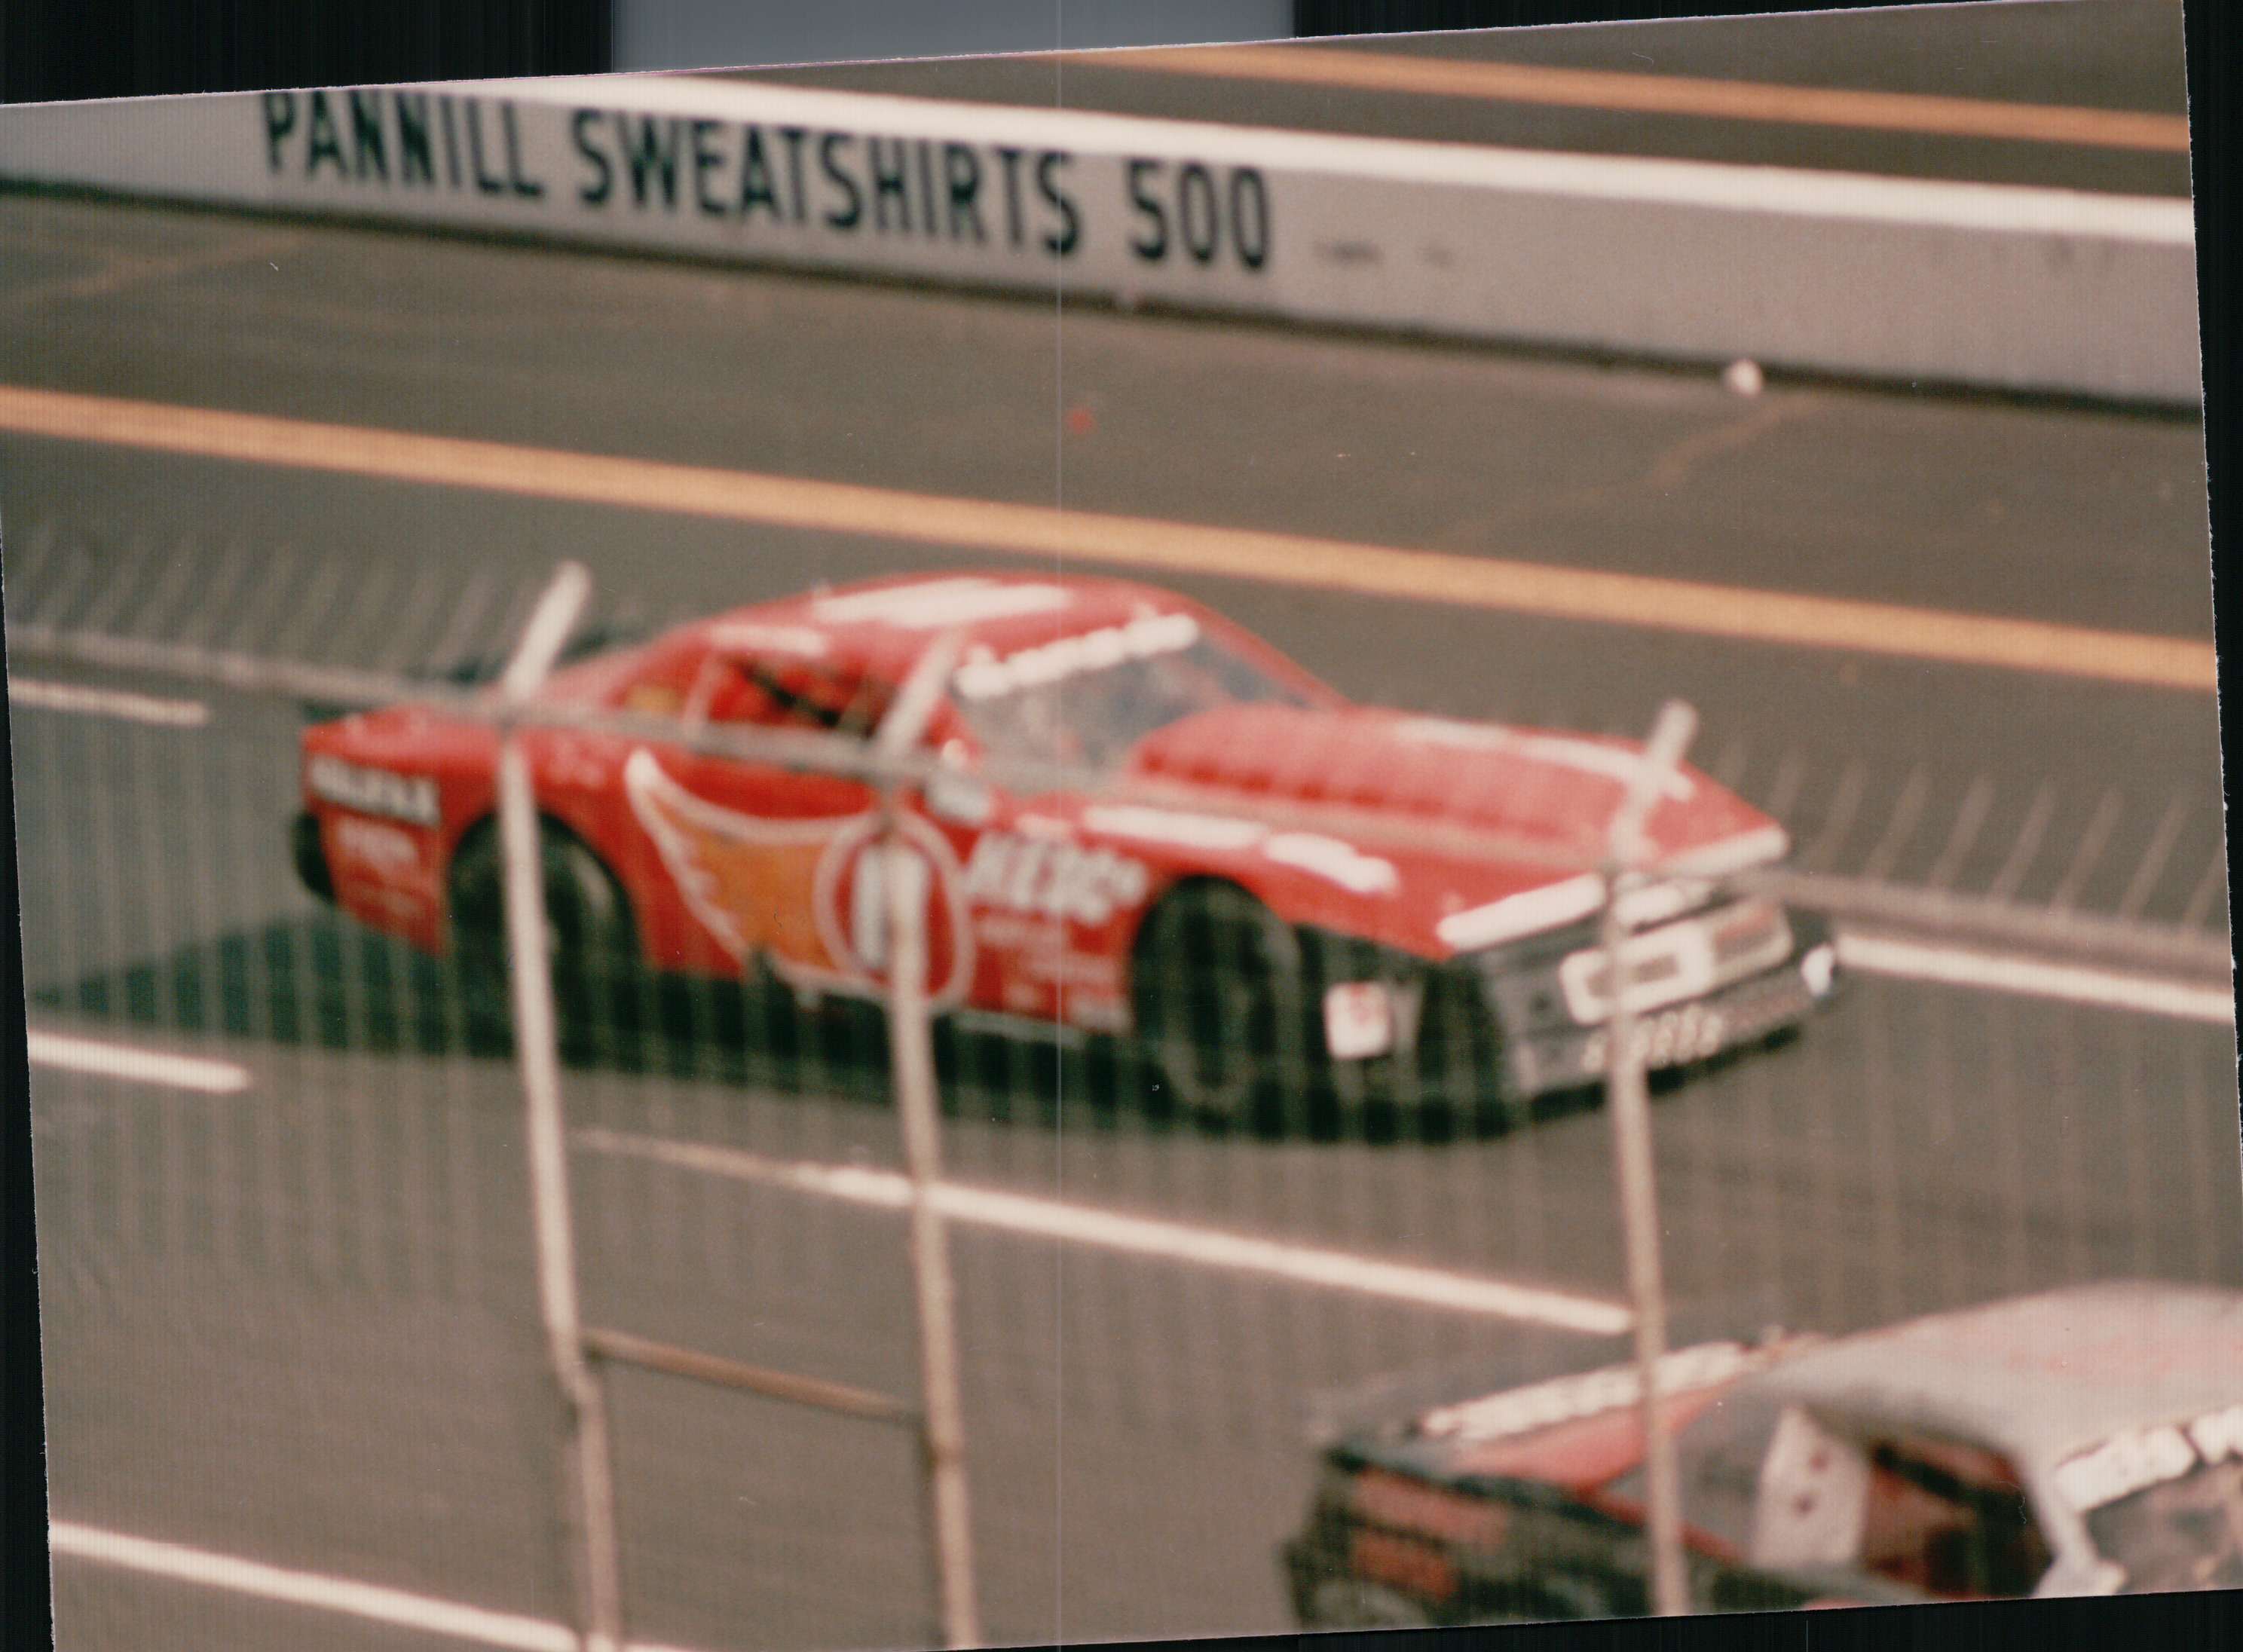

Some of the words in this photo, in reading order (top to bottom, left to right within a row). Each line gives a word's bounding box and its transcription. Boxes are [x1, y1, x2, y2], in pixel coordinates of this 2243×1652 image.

[261, 88, 544, 197] PANNILL
[574, 109, 1084, 258] SWEATSHIRTS
[1122, 160, 1271, 270] 500
